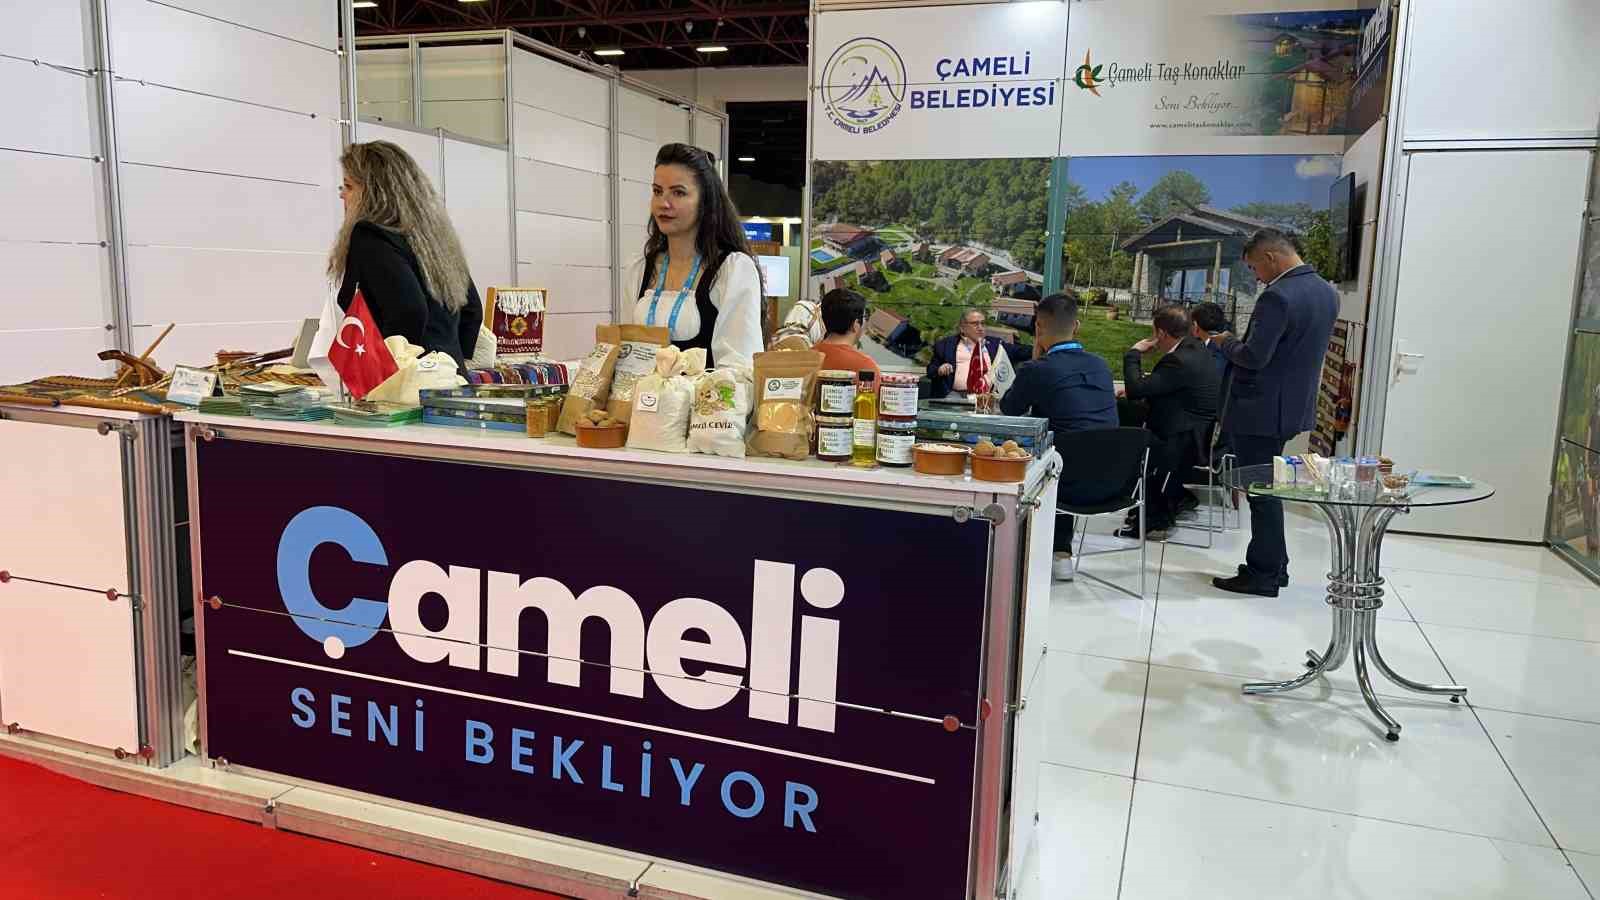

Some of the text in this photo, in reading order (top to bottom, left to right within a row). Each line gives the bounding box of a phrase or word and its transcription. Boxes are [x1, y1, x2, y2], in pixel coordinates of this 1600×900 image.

[936, 51, 1031, 81] ÇAMELİ
[1108, 60, 1246, 87] Çameli Taş Konaklar
[910, 81, 1055, 109] BELEDİYESİ
[276, 505, 846, 733] Çameli
[290, 686, 820, 834] SENİ BEKLİYOR
